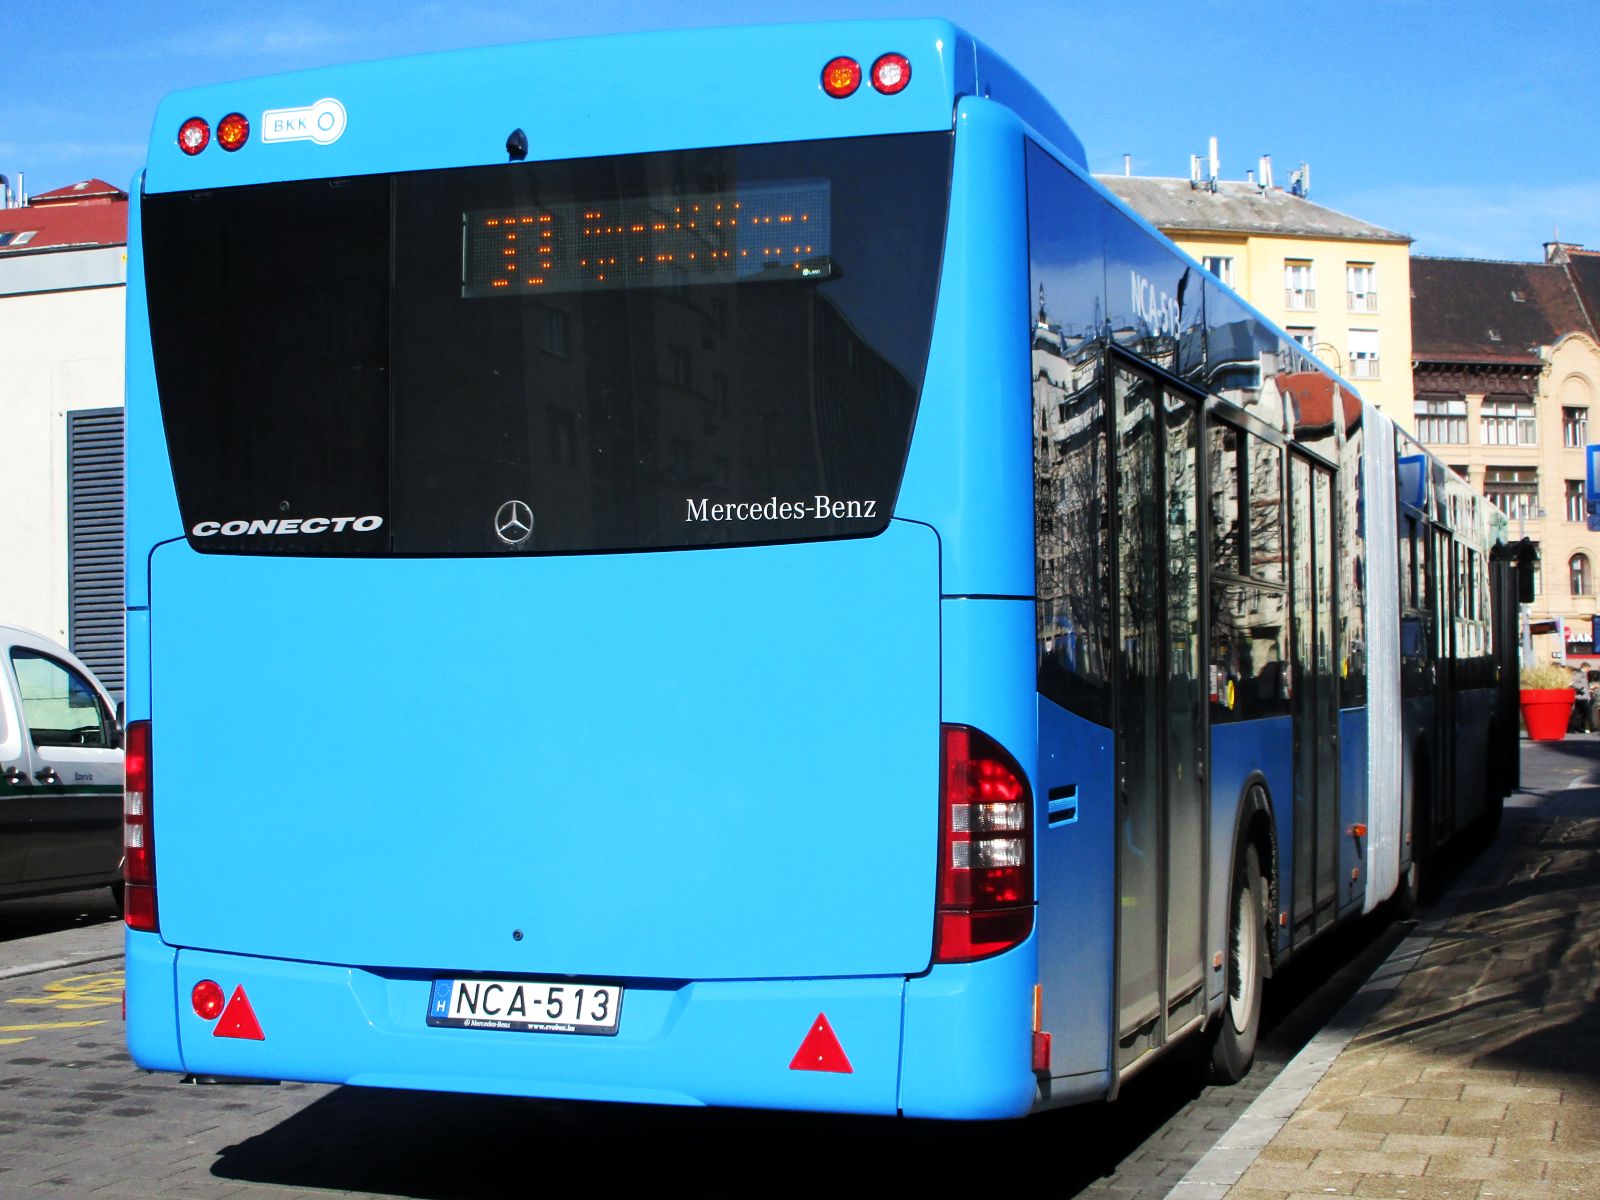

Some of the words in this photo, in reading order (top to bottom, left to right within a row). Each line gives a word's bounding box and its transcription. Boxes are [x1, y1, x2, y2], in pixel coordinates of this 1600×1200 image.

[274, 118, 307, 132] BKK
[685, 495, 877, 522] Mercedes-Benz
[192, 515, 384, 537] CONECTO
[436, 1000, 446, 1013] H
[456, 982, 609, 1022] NCA-513
[470, 1019, 511, 1029] Mercedes-Benz
